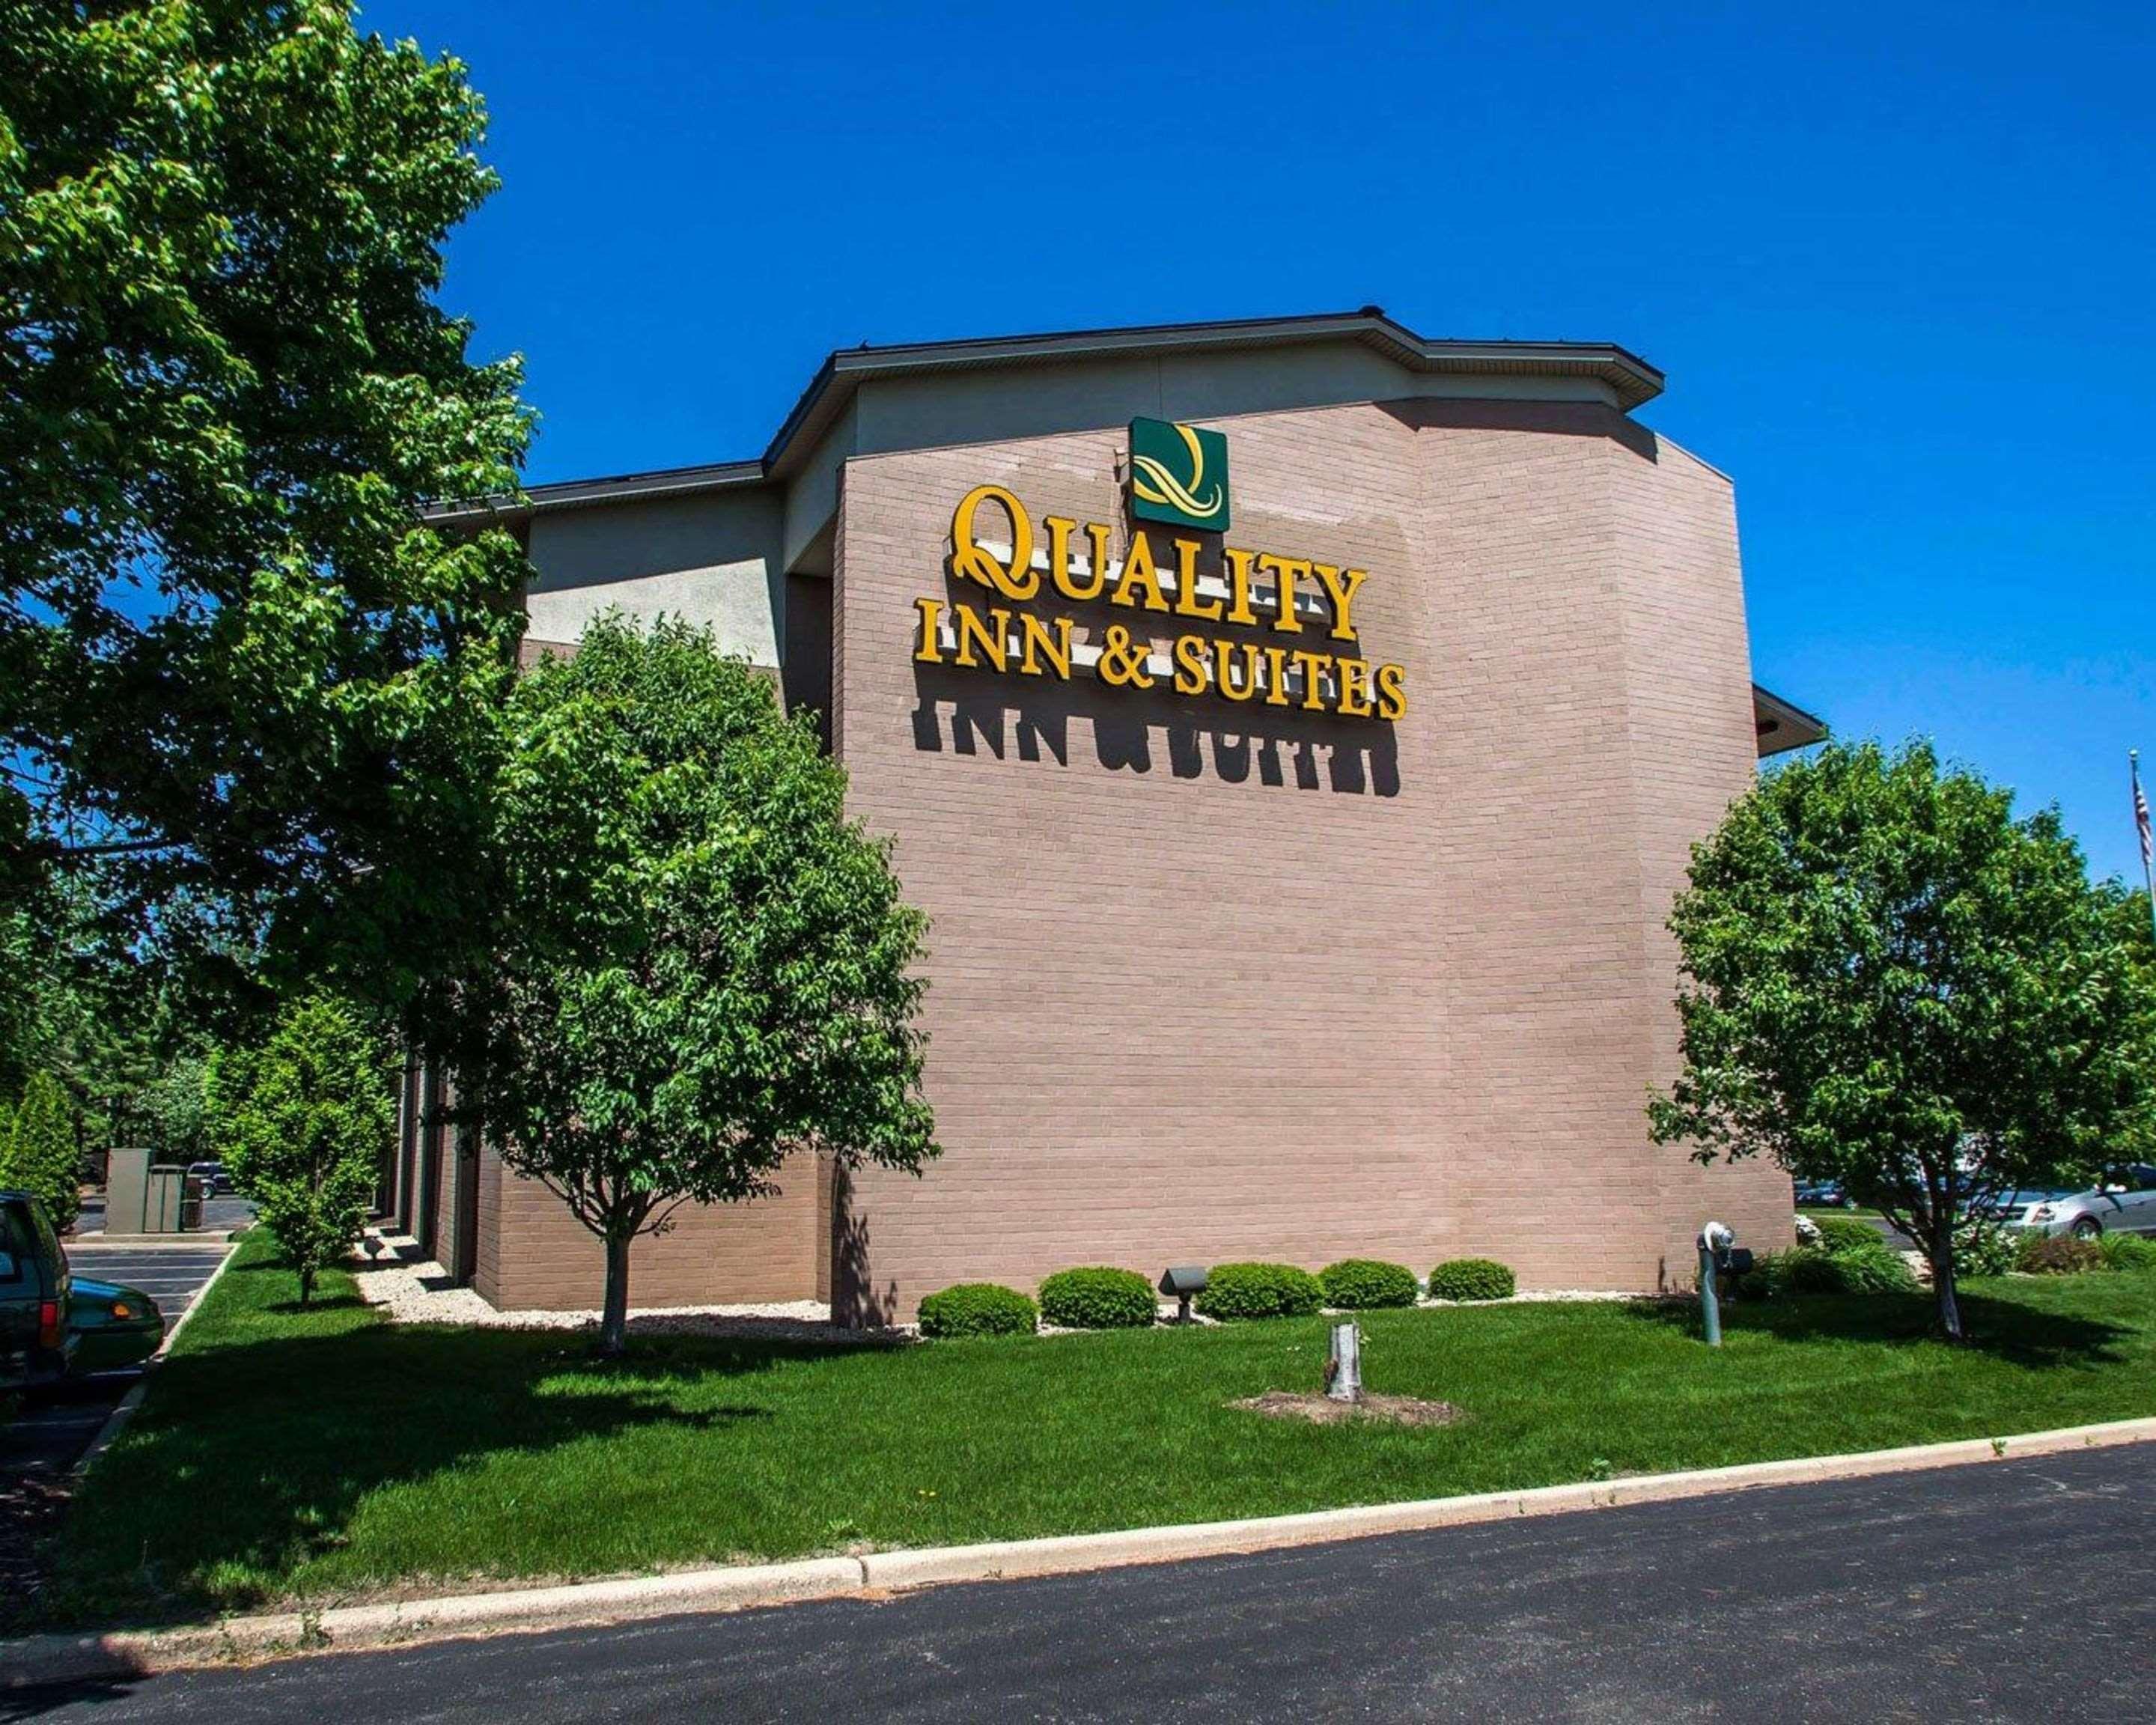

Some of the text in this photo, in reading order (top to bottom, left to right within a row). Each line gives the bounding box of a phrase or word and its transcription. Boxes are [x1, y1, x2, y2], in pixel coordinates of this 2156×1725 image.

[951, 484, 1368, 642] QUALITY
[914, 597, 1408, 722] INN & SUITES
